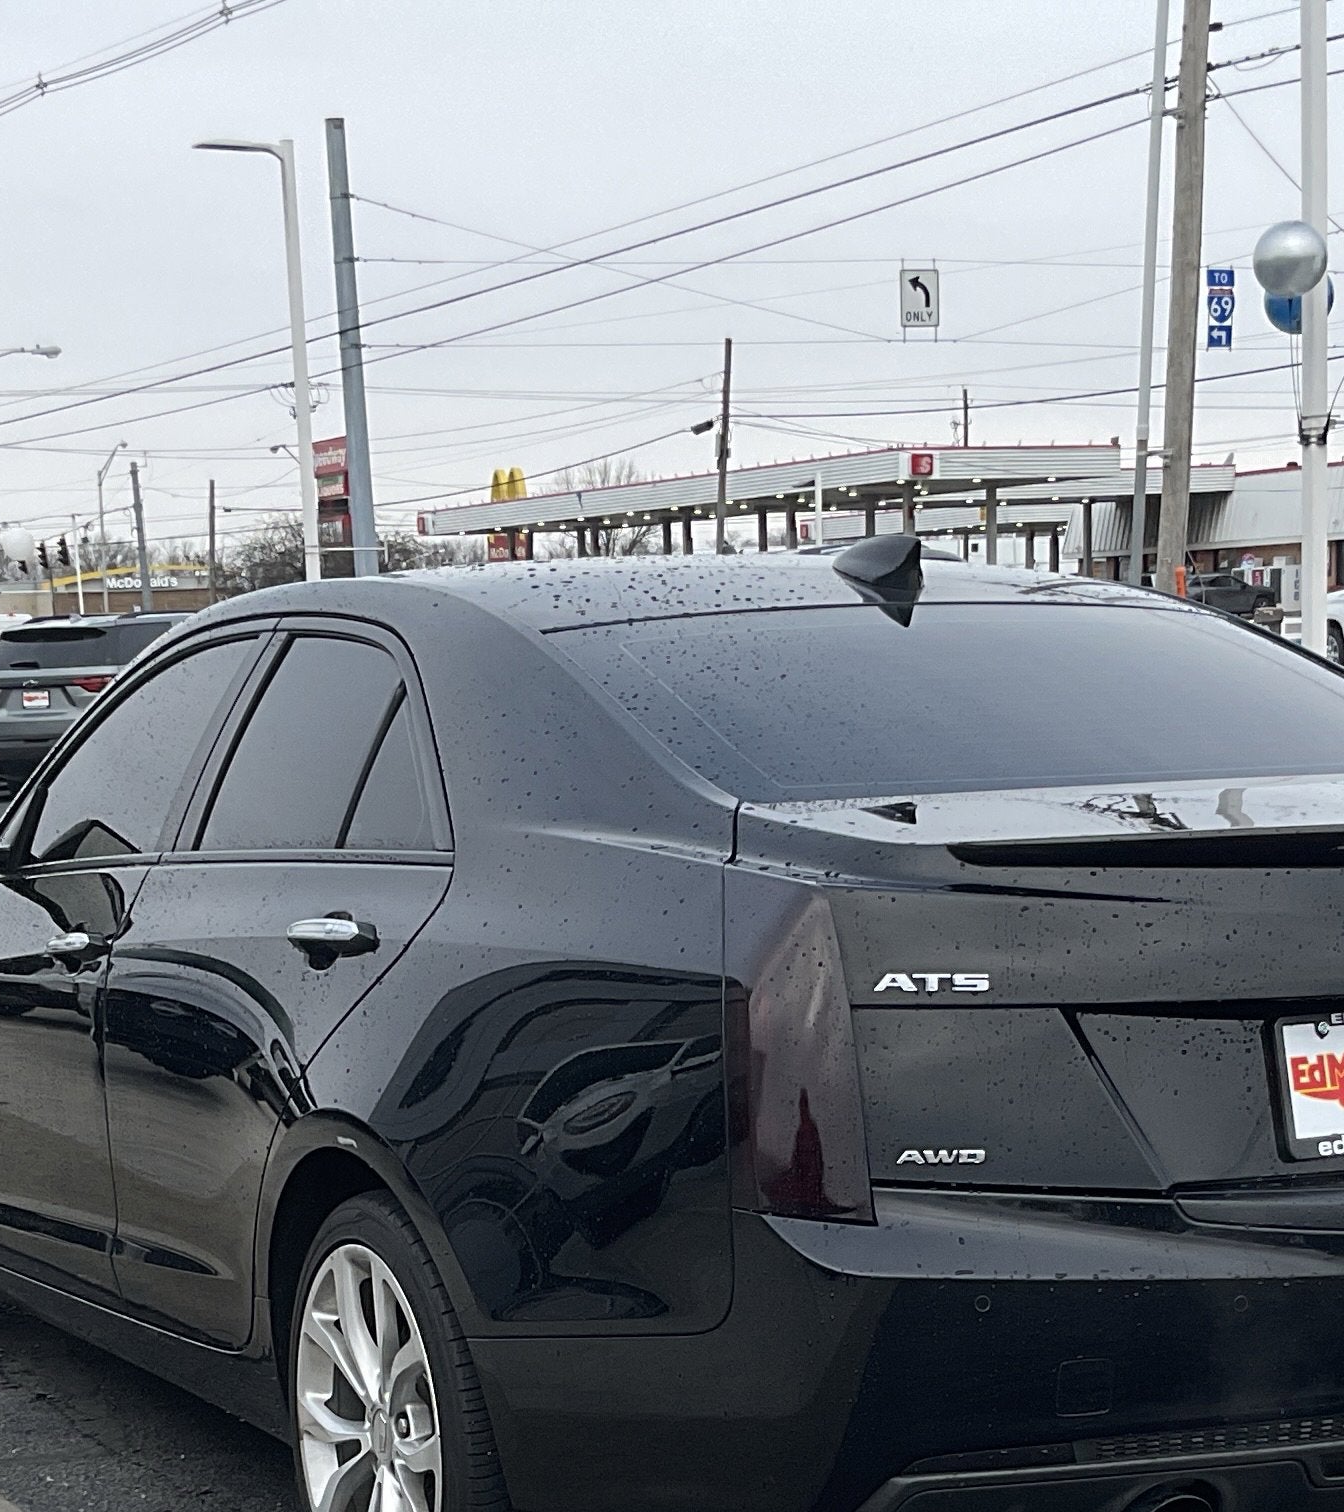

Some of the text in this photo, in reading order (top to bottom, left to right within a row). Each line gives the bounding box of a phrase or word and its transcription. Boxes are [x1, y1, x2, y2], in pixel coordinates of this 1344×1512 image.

[1213, 272, 1228, 284] TO
[1210, 297, 1232, 317] 69
[905, 311, 933, 322] ONLY
[106, 577, 178, 588] McDoald's
[873, 973, 990, 992] ATS
[896, 1149, 986, 1165] AWD
